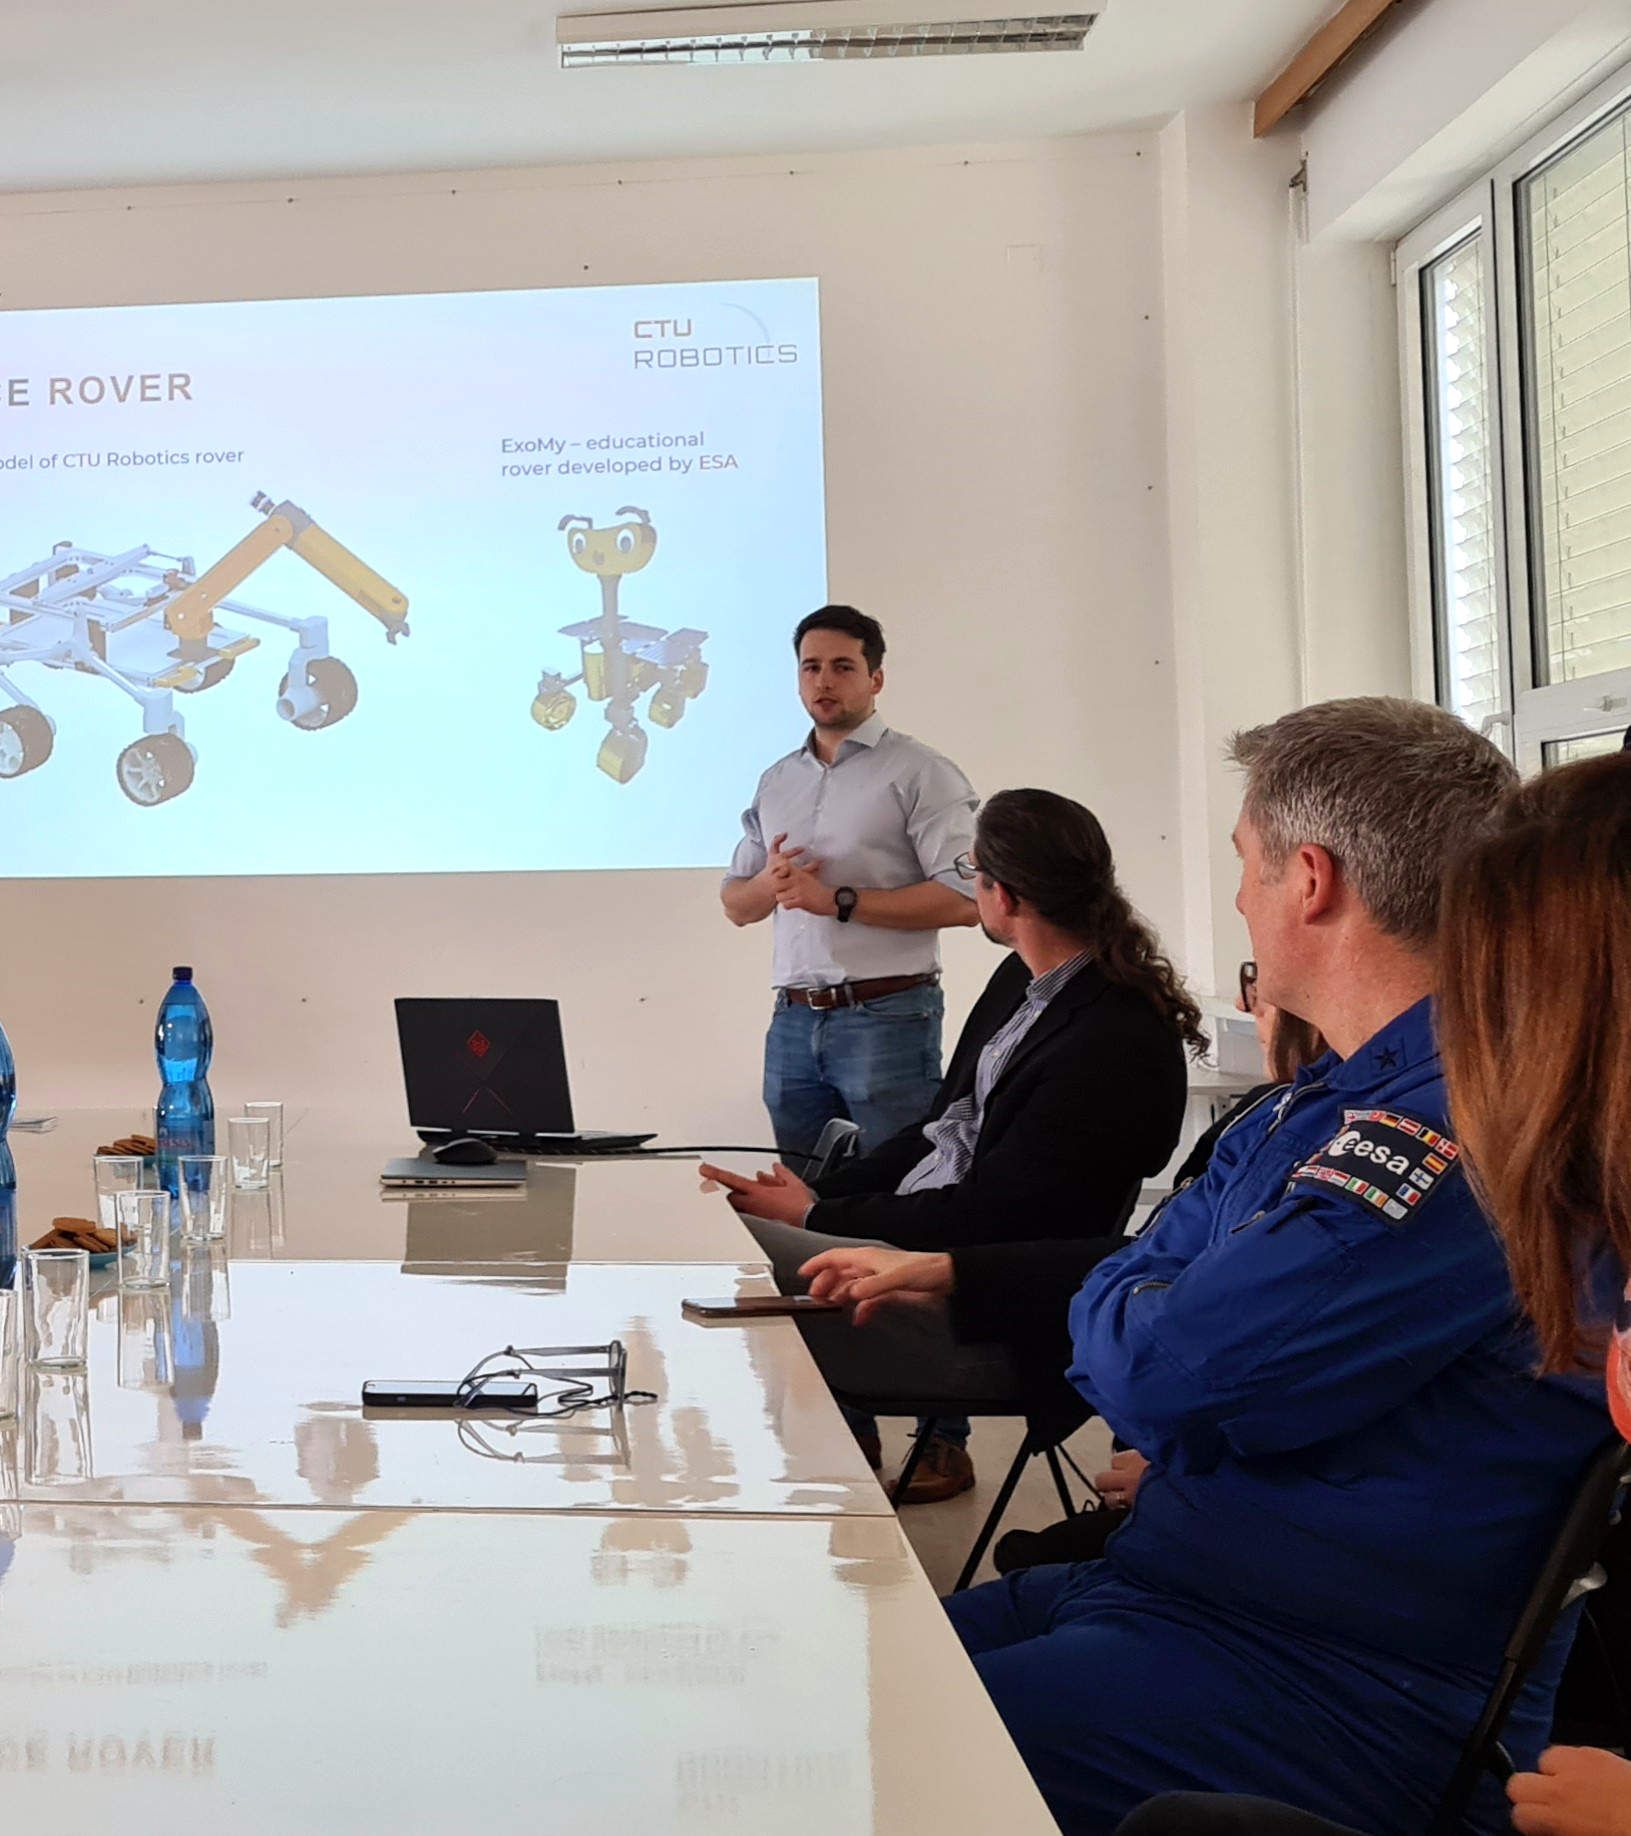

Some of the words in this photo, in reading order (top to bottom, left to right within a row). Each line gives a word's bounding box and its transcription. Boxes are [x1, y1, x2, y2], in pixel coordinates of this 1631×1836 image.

[633, 318, 693, 339] CTU
[633, 344, 798, 369] ROBOTICS
[49, 373, 193, 405] ROVER
[501, 437, 566, 455] ExoMy
[586, 431, 705, 450] educational
[38, 453, 58, 470] of
[62, 453, 101, 468] CTU
[106, 450, 190, 468] Robotics
[195, 450, 244, 465] rover
[501, 461, 551, 477] rover
[558, 457, 662, 476] developed
[669, 455, 693, 473] by
[699, 454, 739, 470] ESA
